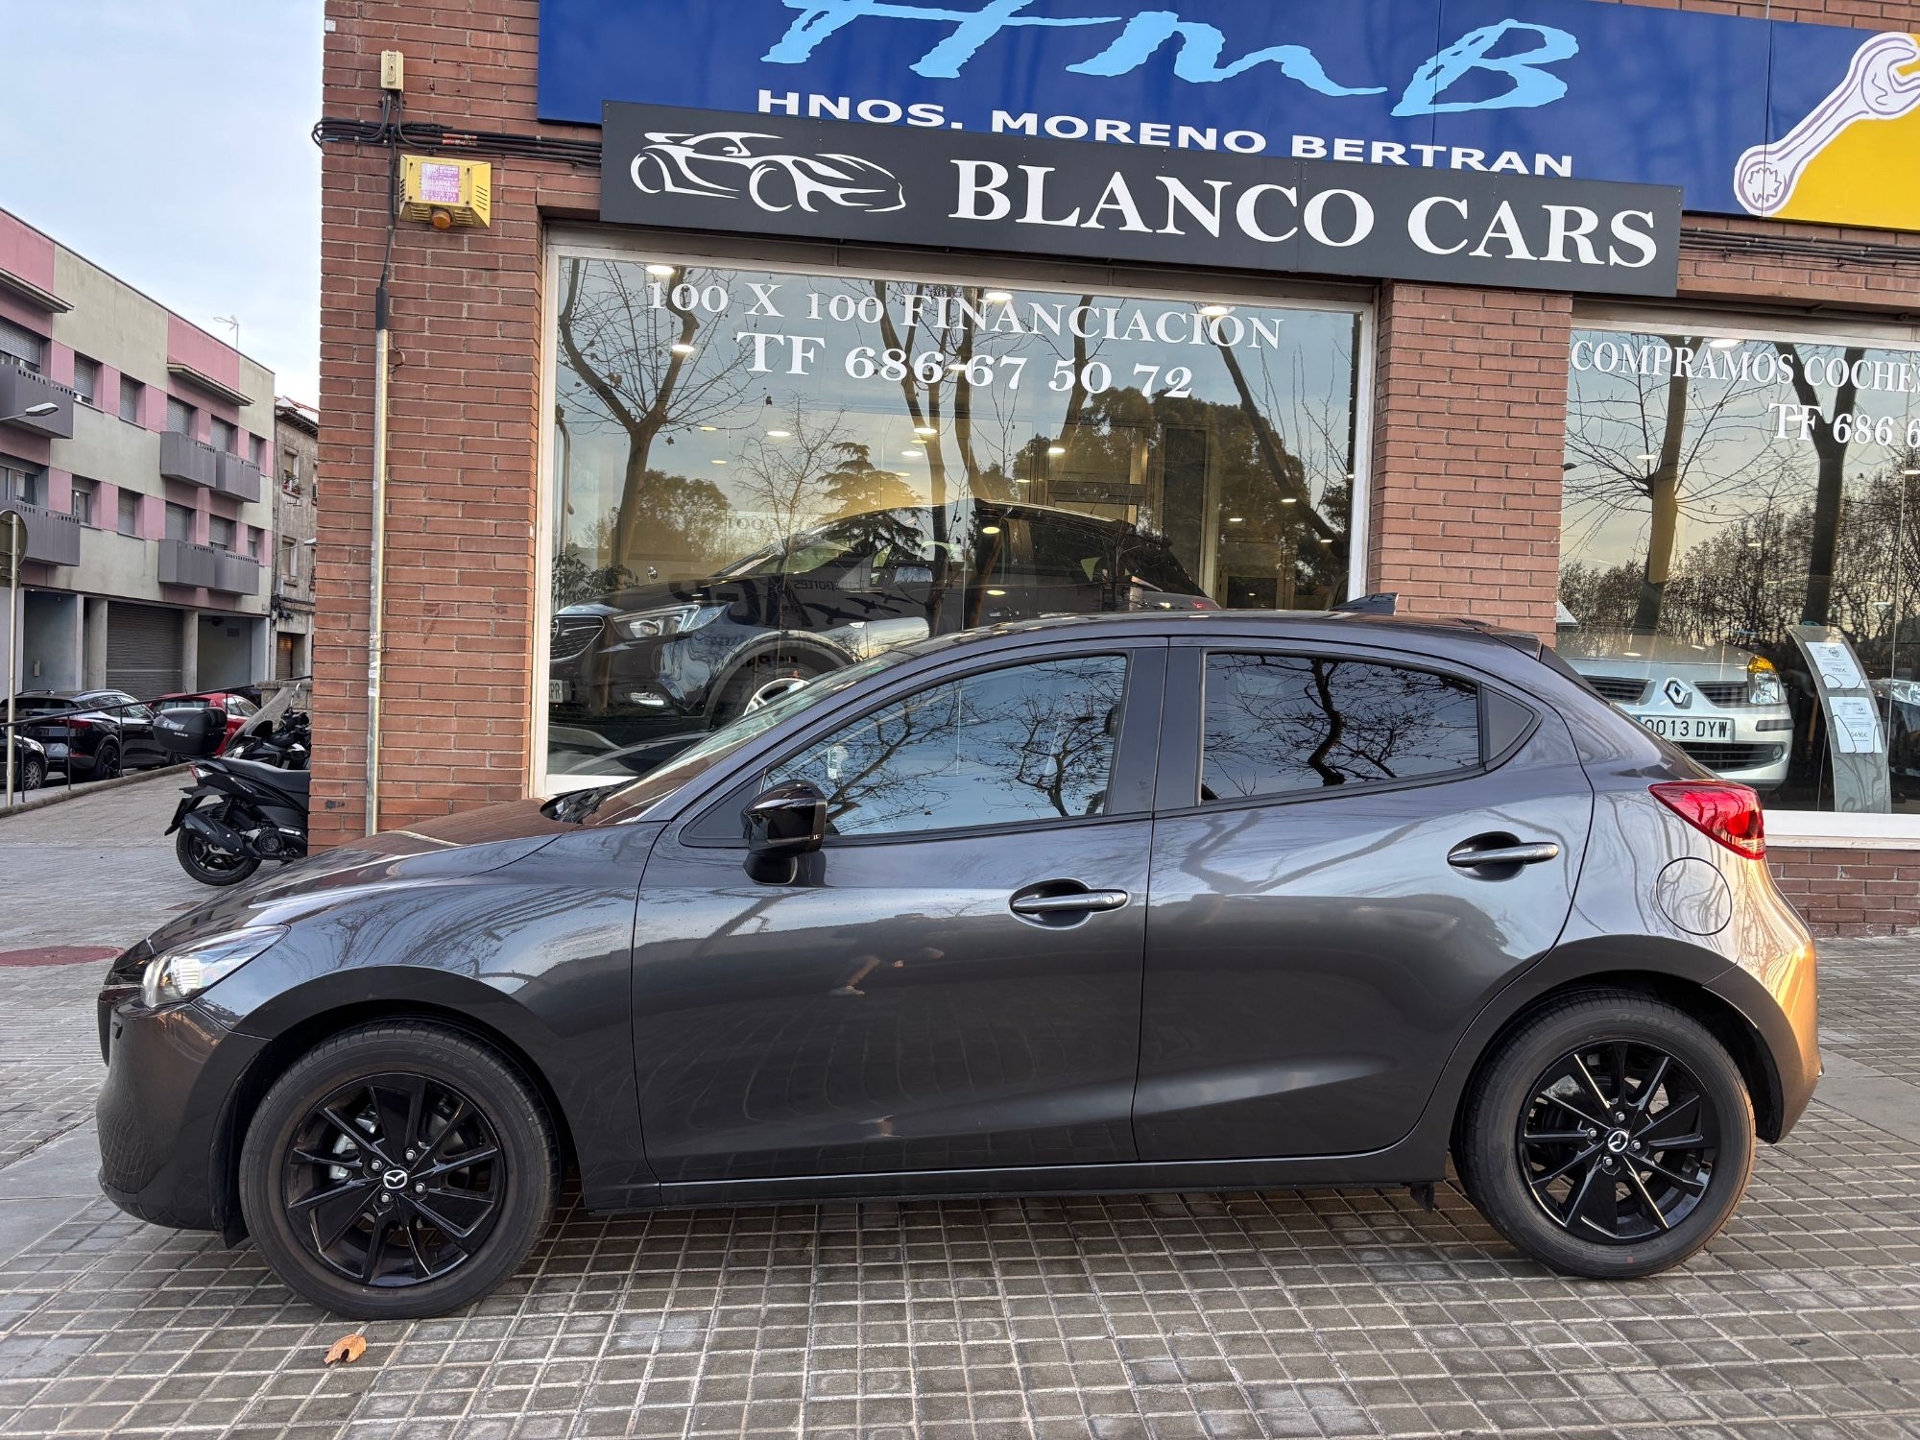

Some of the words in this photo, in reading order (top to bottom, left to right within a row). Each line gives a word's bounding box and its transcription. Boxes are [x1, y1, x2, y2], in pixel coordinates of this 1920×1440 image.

[758, 89, 963, 130] HNOS.
[992, 110, 1267, 154] MORENO
[1291, 135, 1572, 178] BERTRAN
[948, 159, 1375, 247] BLANCO
[1407, 197, 1657, 268] CARS
[647, 281, 729, 313] 100
[744, 283, 785, 317] X
[806, 292, 885, 324] 100
[736, 331, 826, 375] TF
[845, 347, 944, 388] 686
[964, 354, 1028, 390] 67
[1048, 359, 1112, 394] 50
[1133, 363, 1193, 399] 72
[1570, 340, 1794, 385] COMPRAMOS
[1803, 356, 1920, 394] COCHE
[1768, 403, 1822, 441] TF
[1833, 413, 1894, 446] 686
[1696, 721, 1728, 738] DYW
